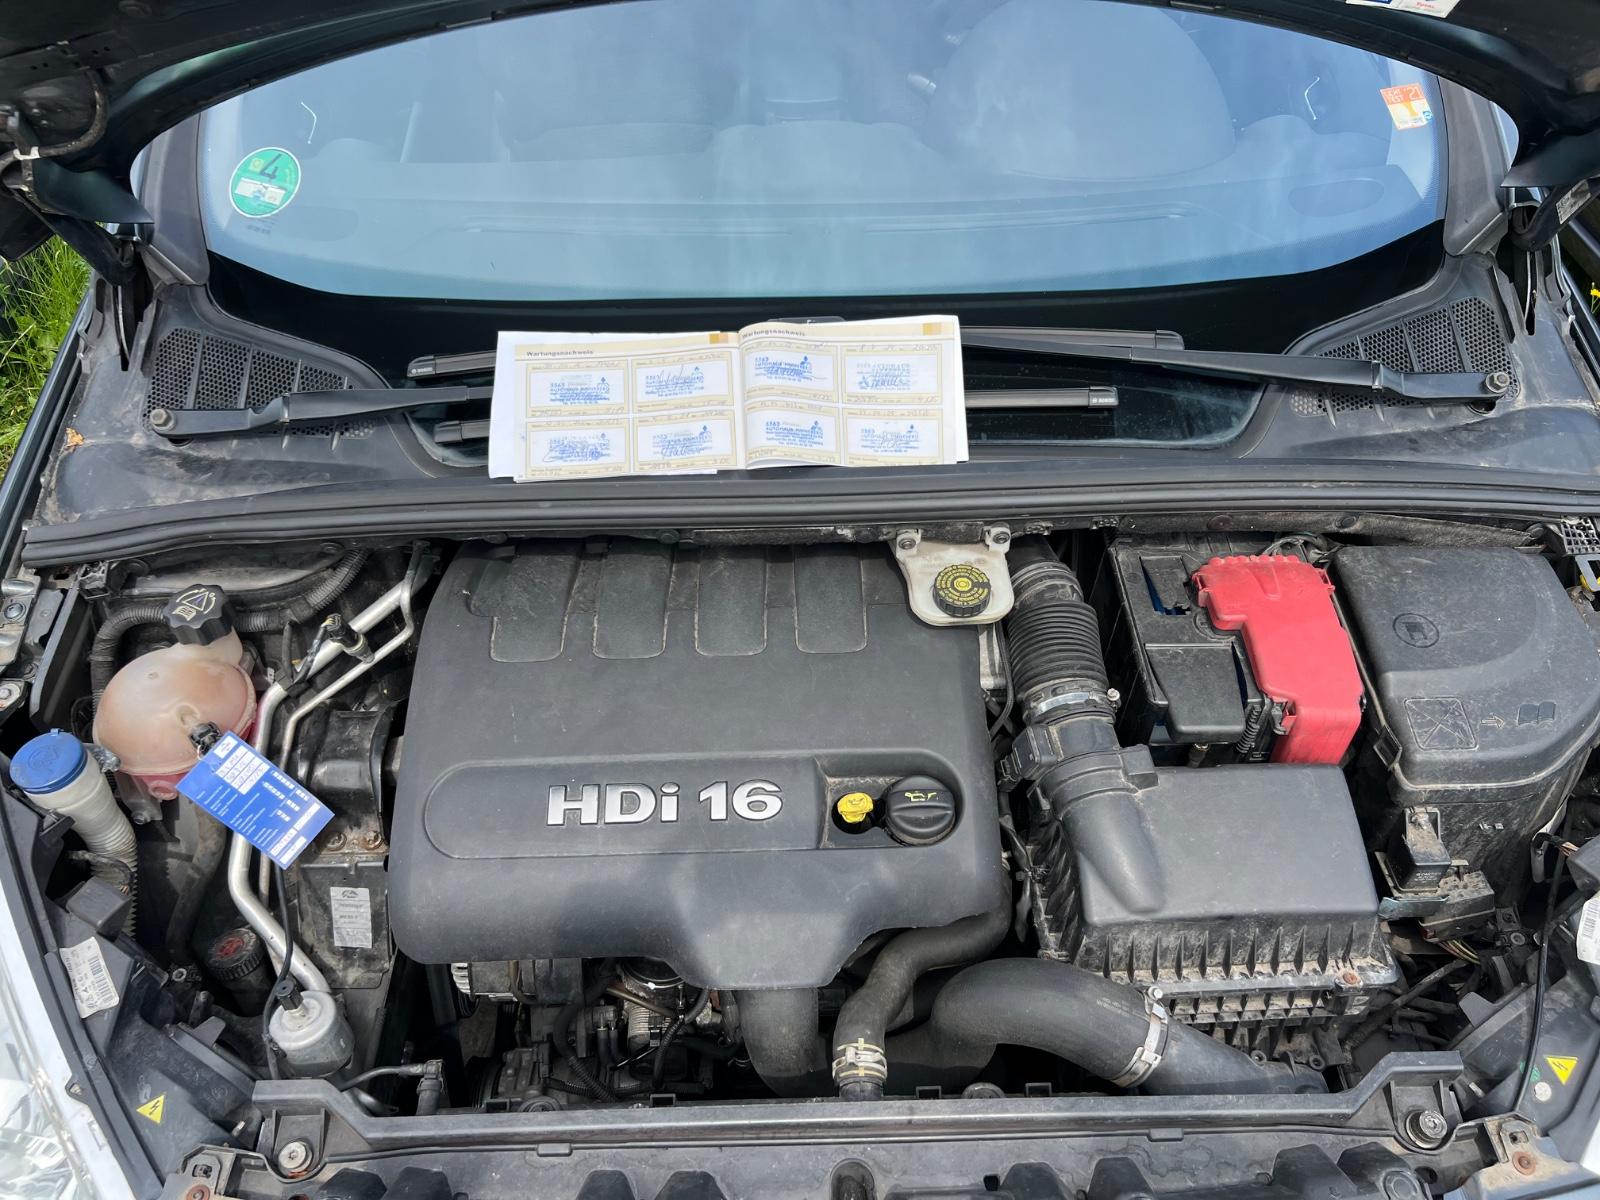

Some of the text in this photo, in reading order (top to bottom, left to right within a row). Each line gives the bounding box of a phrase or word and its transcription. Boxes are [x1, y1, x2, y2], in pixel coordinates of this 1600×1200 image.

[260, 153, 283, 182] 4
[526, 349, 594, 357] Wartungsnachweis
[547, 779, 783, 825] HDi 16
